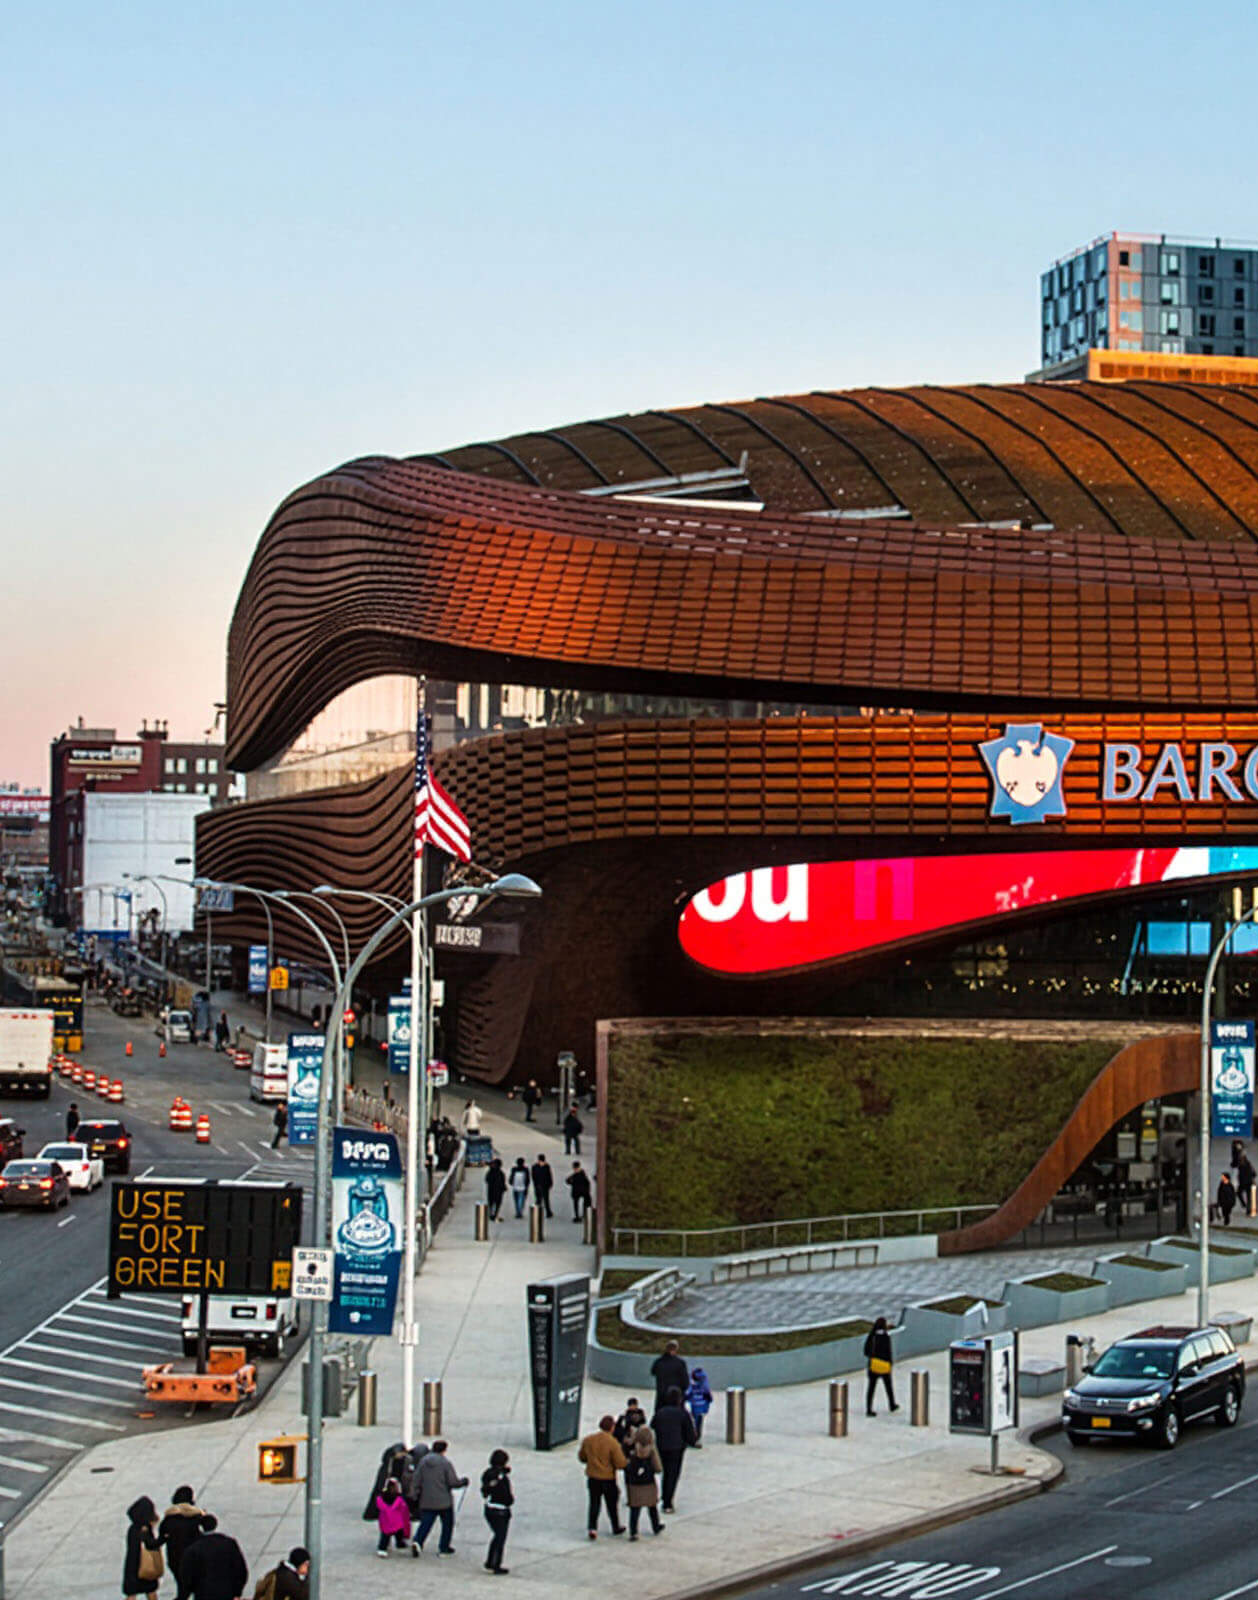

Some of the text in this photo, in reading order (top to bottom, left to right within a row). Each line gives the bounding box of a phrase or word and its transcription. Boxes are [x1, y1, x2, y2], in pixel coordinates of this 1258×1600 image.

[117, 1189, 185, 1221] USE
[119, 1223, 205, 1254] FORT
[115, 1257, 225, 1288] GREEN
